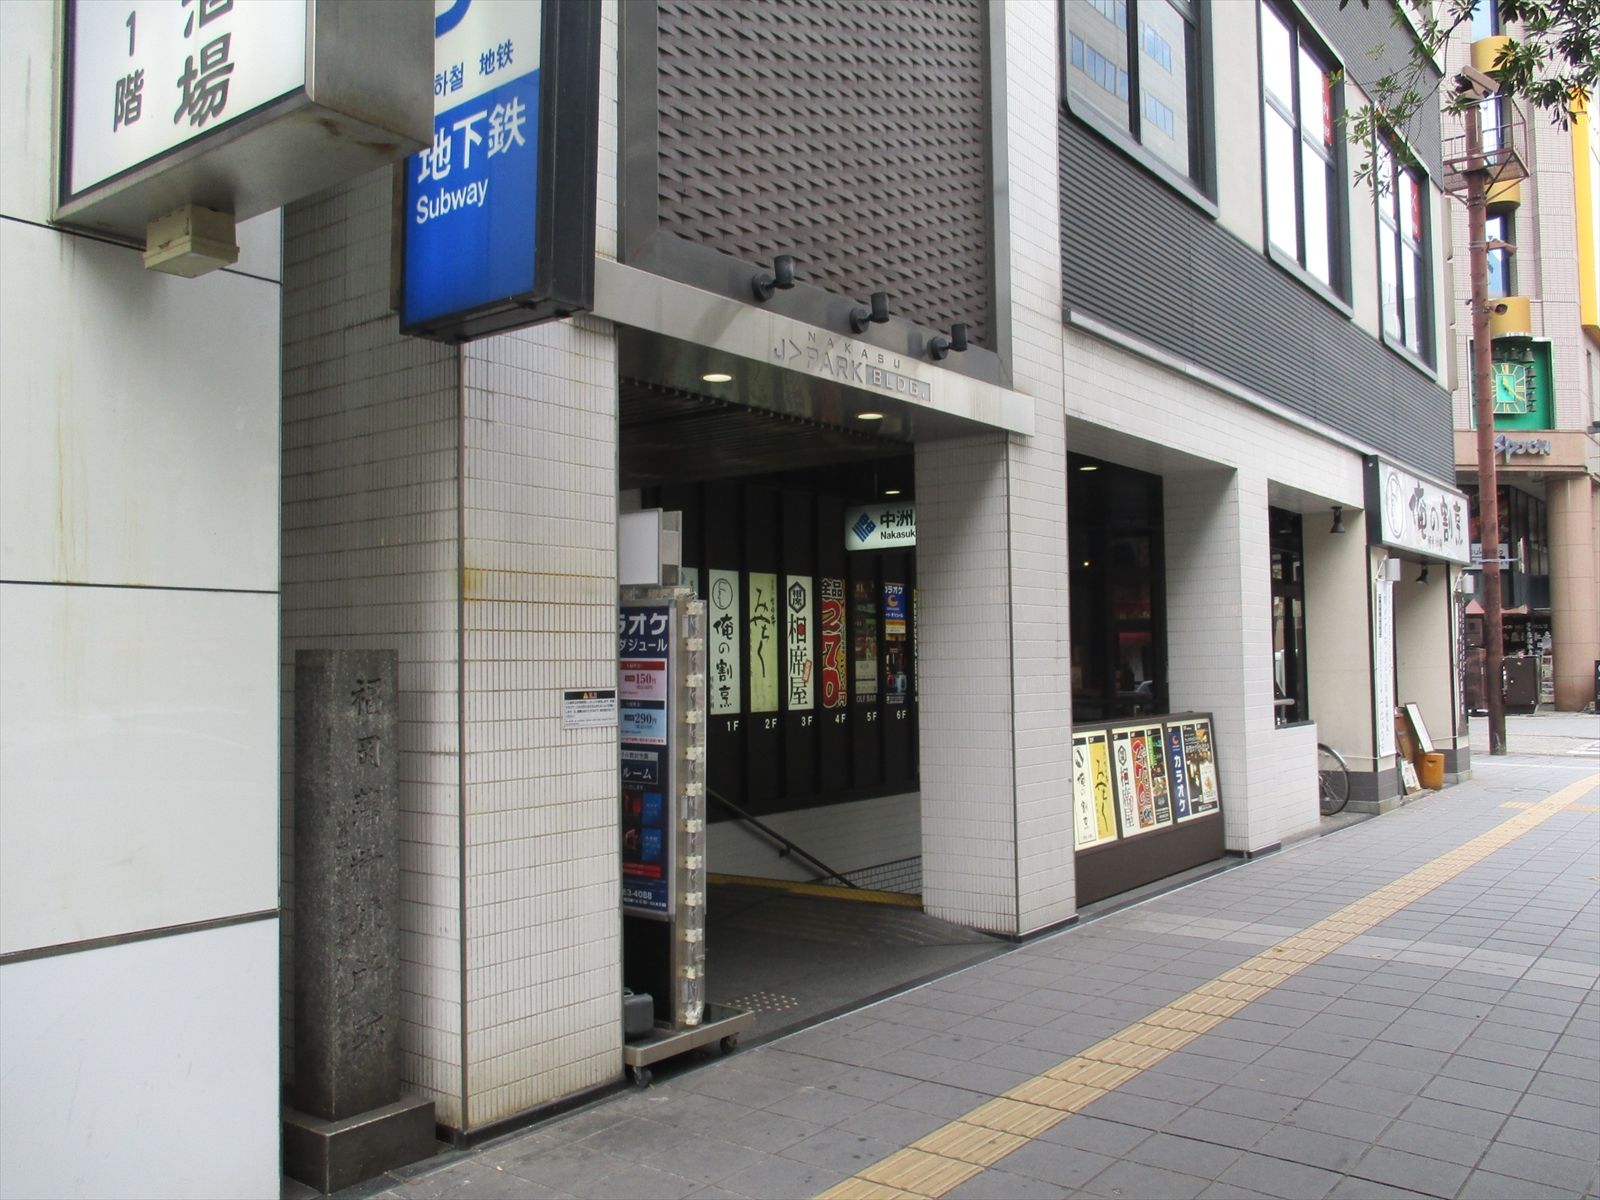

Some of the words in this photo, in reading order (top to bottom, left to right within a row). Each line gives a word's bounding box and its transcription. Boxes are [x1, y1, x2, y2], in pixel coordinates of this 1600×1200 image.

[479, 39, 514, 76] 地铁
[416, 96, 527, 185] 地下鉄
[416, 178, 488, 225] Subway
[807, 331, 901, 369] NAKASU
[880, 509, 917, 528] 中洲
[789, 613, 810, 706] 相席屋
[765, 718, 778, 730] 2F
[801, 715, 813, 728] 3F
[835, 713, 847, 725] 4F
[867, 711, 878, 723] 5F
[896, 710, 907, 721] 6F
[726, 720, 740, 733] 1F
[1174, 755, 1187, 813] カラオケ
